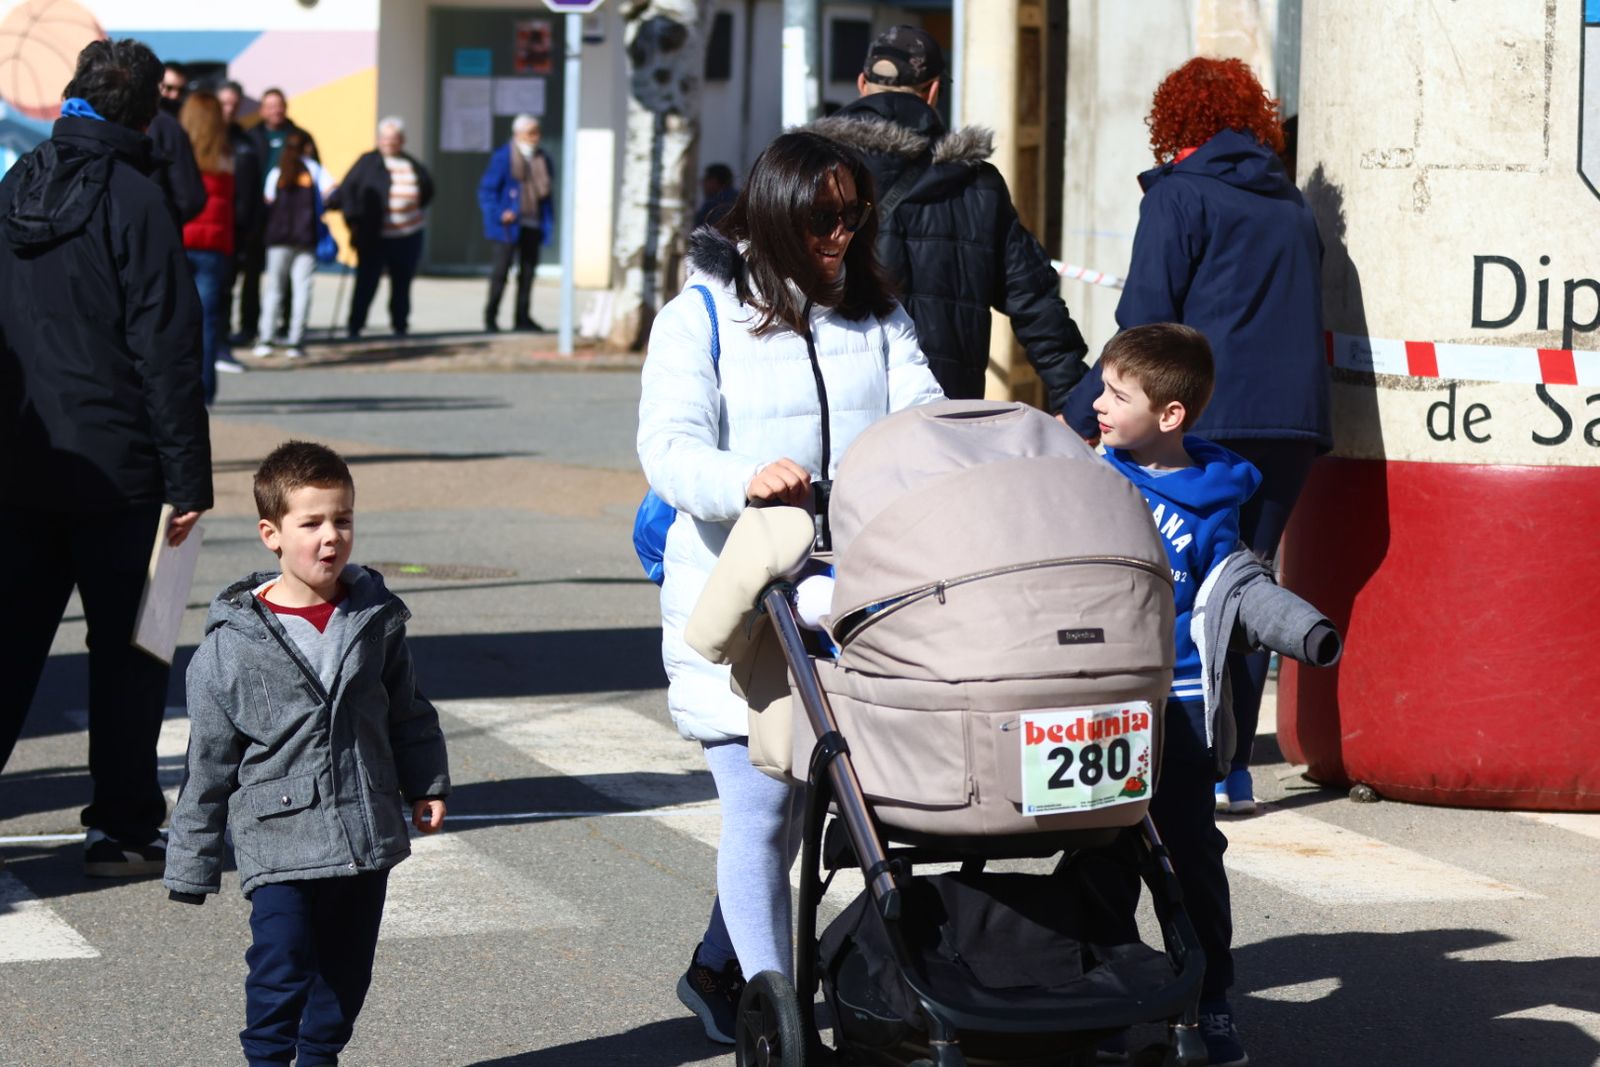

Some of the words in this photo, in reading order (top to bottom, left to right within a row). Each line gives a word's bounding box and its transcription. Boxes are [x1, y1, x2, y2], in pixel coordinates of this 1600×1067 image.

[1471, 255, 1600, 349] Dip
[1427, 383, 1492, 443] de
[1145, 498, 1193, 553] ANA
[1025, 710, 1149, 745] bedunia
[1047, 738, 1131, 789] 280
